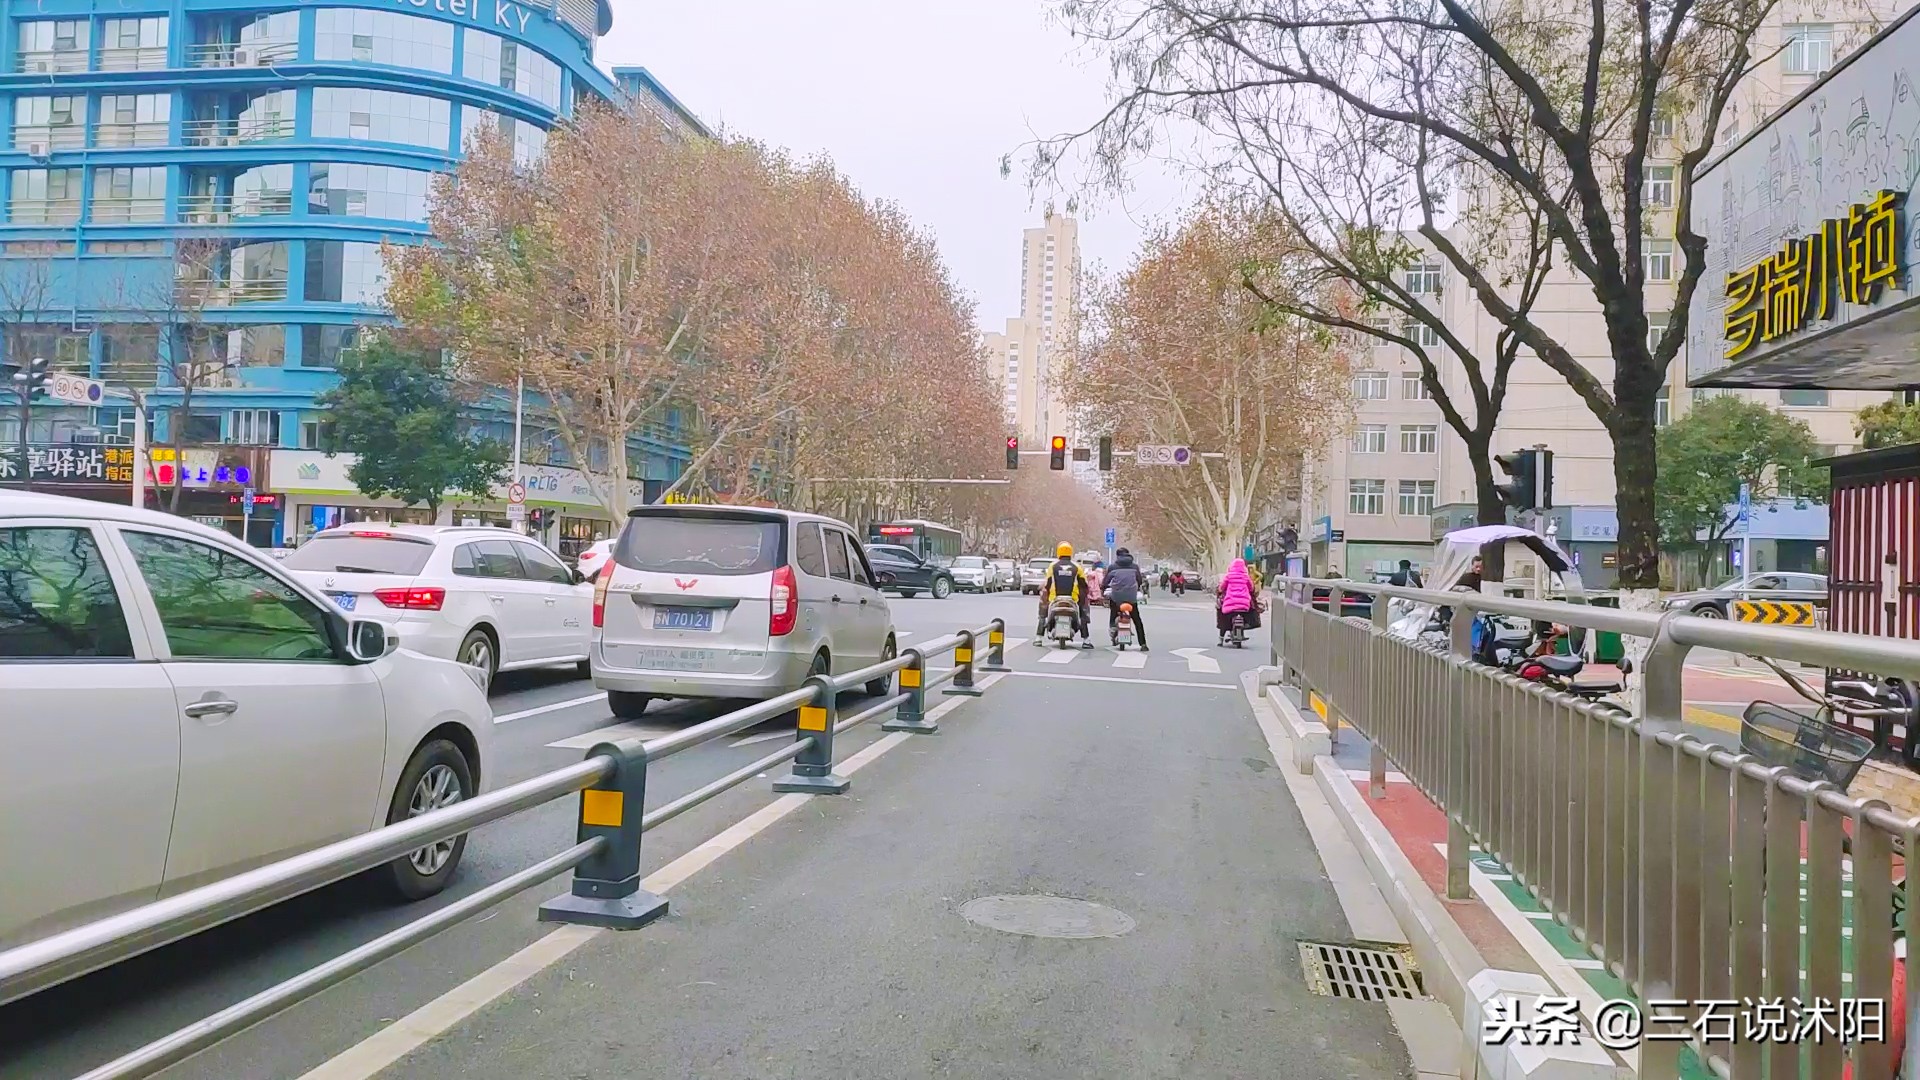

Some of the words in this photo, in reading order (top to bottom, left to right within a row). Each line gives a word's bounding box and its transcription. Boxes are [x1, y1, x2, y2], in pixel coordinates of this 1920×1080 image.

[495, 1, 531, 34] KY
[1723, 190, 1898, 359] 多瑞小镇
[57, 382, 67, 392] 50
[1142, 450, 1152, 458] 50
